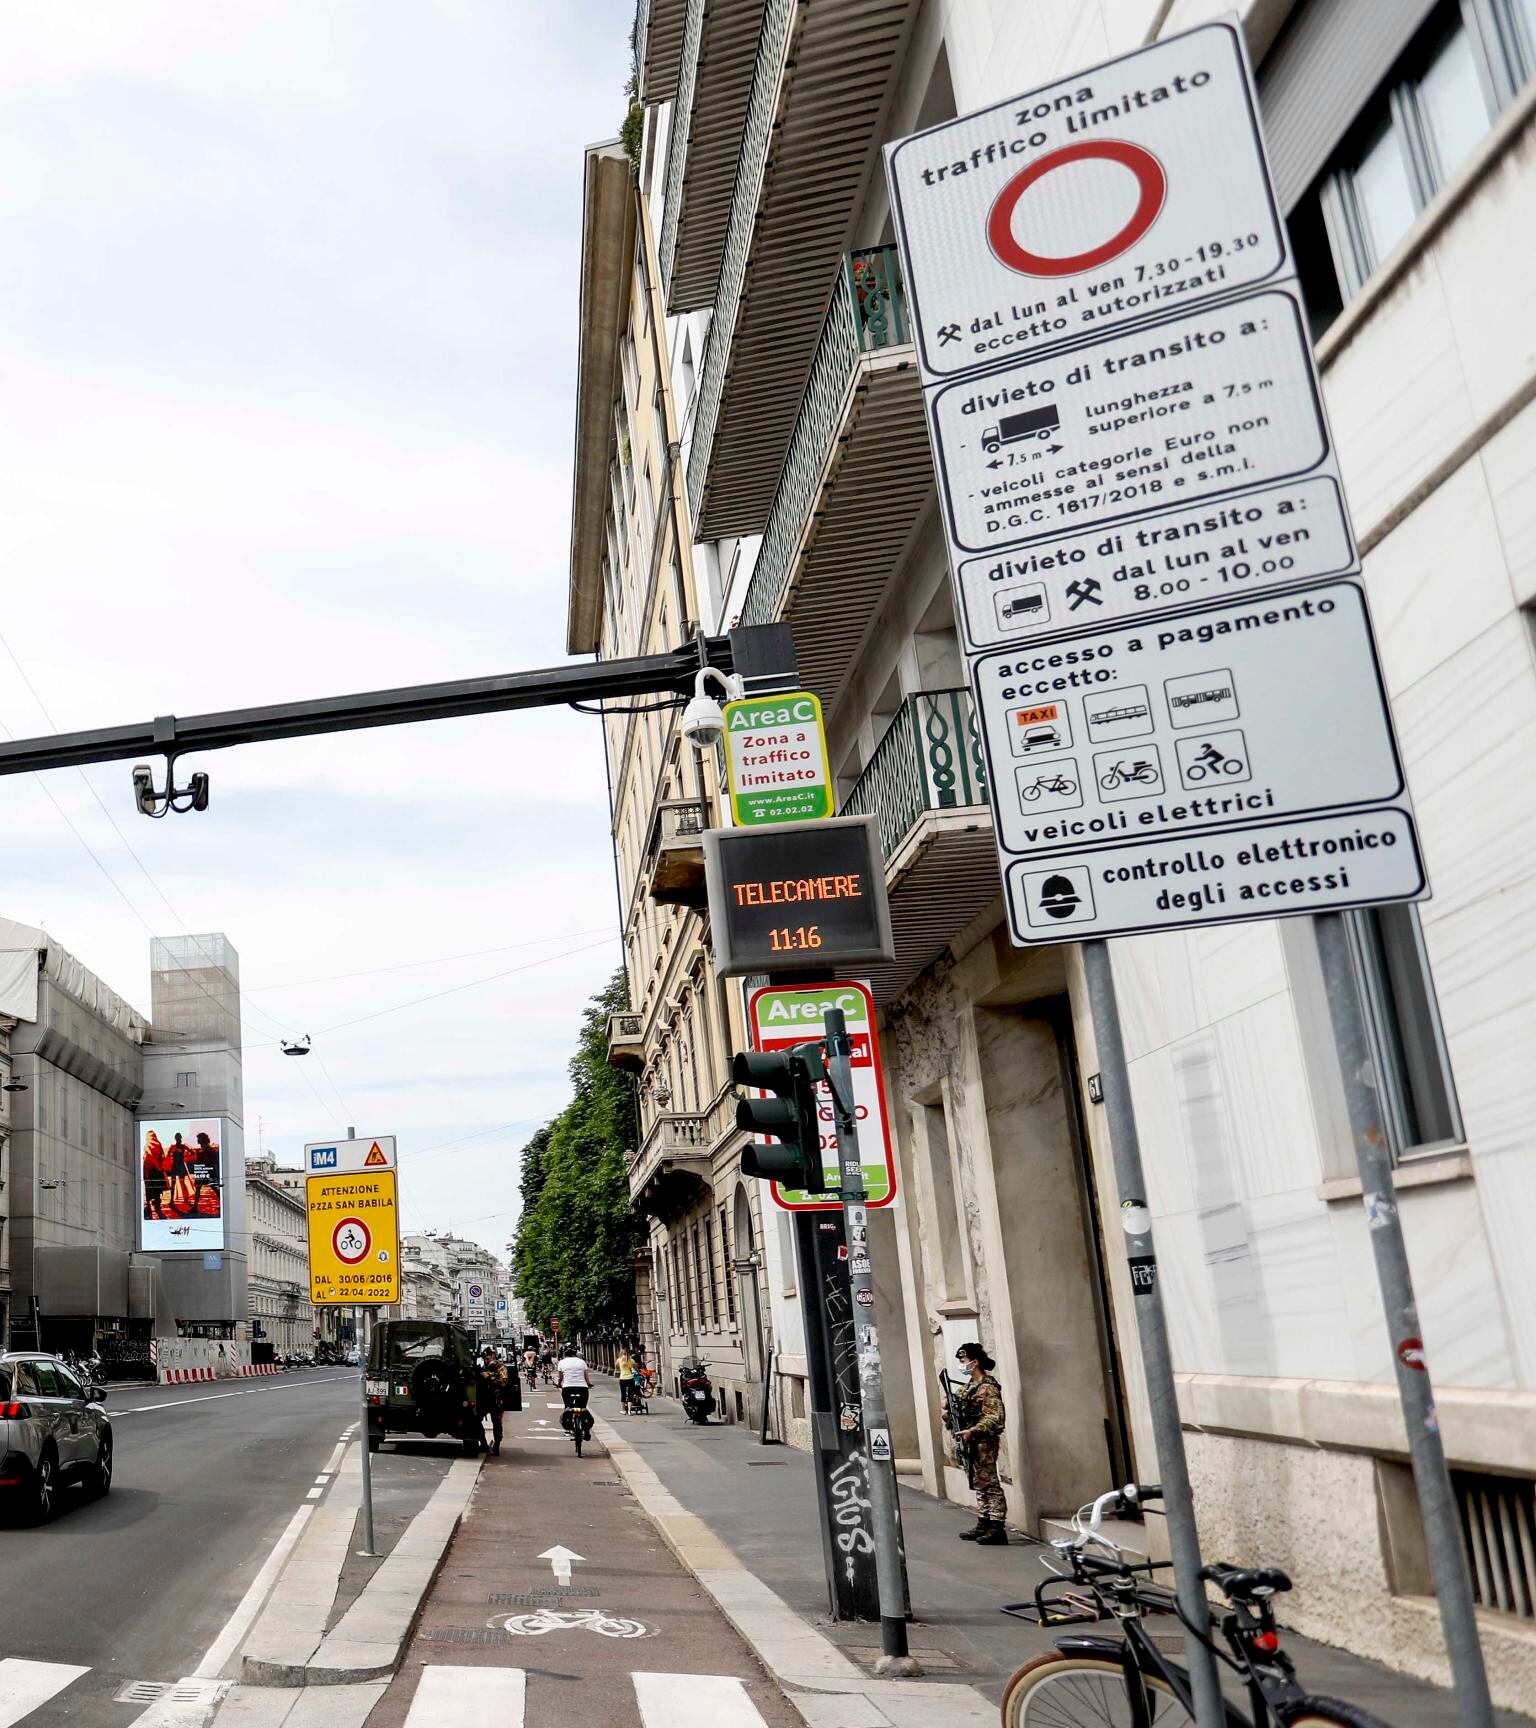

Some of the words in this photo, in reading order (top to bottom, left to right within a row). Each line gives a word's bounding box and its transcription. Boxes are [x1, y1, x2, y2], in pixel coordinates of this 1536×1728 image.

[1015, 84, 1095, 127] zona
[921, 130, 1048, 187] traffico
[1066, 68, 1212, 134] limitato
[970, 312, 1004, 335] dal
[1011, 298, 1047, 322] lun
[1056, 287, 1079, 309] al
[1087, 276, 1125, 299] ven
[974, 315, 1068, 355] eccetto
[1081, 264, 1226, 322] autorizzati
[960, 376, 1056, 416] divieto
[1065, 363, 1092, 386] di
[1103, 327, 1227, 375] transito
[1240, 316, 1269, 337] a:
[1084, 379, 1194, 419] lunghezza
[1088, 396, 1192, 436] superiore
[1202, 392, 1215, 405] a
[1222, 381, 1252, 400] 7.5
[1257, 377, 1274, 390] m
[980, 471, 1045, 499] veicoli
[1055, 445, 1153, 480] categorie
[1165, 428, 1216, 451] Euro
[1228, 416, 1270, 435] non
[983, 483, 1075, 514] ammesse
[1086, 474, 1104, 489] ai
[1116, 457, 1169, 482] sensi
[1181, 442, 1236, 464] della
[1006, 450, 1028, 467] 7.5
[1031, 450, 1042, 461] m
[987, 508, 1051, 533] D.G.C.
[1174, 476, 1185, 487] e
[1198, 457, 1255, 481] s.m.i.
[988, 548, 1086, 581] divieto
[1097, 536, 1123, 556] di
[1136, 507, 1263, 547] transito
[1277, 498, 1307, 514] a:
[1113, 560, 1155, 582] dal
[1164, 550, 1210, 572] lun
[1220, 538, 1248, 558] al
[1257, 527, 1310, 549] ven
[1133, 578, 1190, 601] 8.00
[1217, 556, 1295, 583] 10.00
[998, 644, 1113, 678] accesso
[1128, 637, 1144, 652] a
[1157, 599, 1336, 650] pagamento
[1001, 666, 1118, 700] eccetto:
[1020, 708, 1055, 723] TAXI
[742, 750, 810, 766] traffico
[743, 735, 788, 748] Zona
[796, 733, 806, 742] a
[741, 770, 816, 786] limitato
[748, 792, 815, 805] www.AreaC.it
[770, 805, 813, 816] 02.02.02
[1023, 811, 1128, 842] veicoli
[1138, 788, 1274, 826] elettrici
[1103, 850, 1225, 884] controllo
[1237, 829, 1397, 867] elettronico
[733, 874, 862, 906] TELECAMERE
[1156, 882, 1226, 913] degli
[1239, 867, 1349, 900] accessi
[768, 926, 822, 951] 11:16
[321, 1185, 379, 1196] ATTENZIONE
[336, 1200, 355, 1210] SAN
[358, 1198, 393, 1208] BABILA
[315, 1275, 331, 1284] DAL
[316, 1290, 327, 1300] AL
